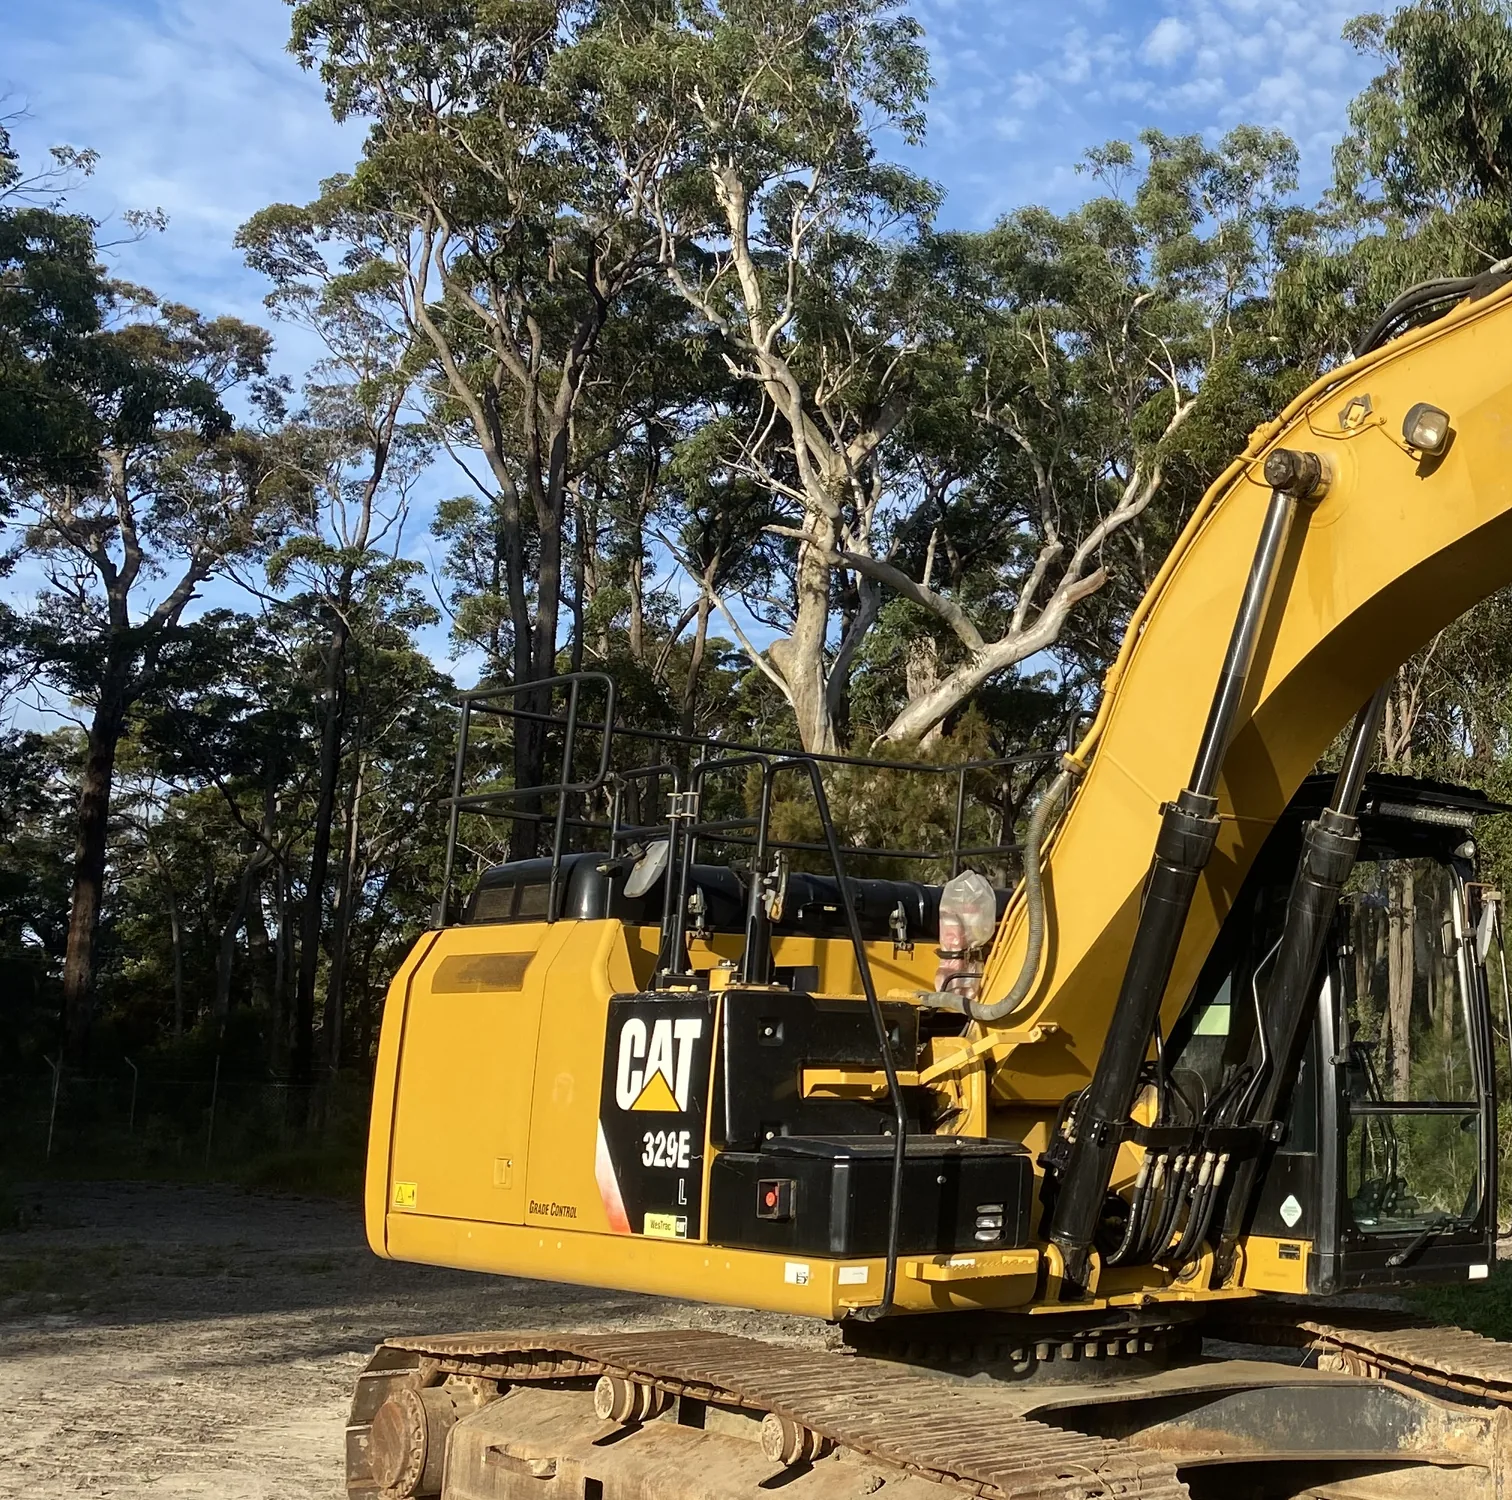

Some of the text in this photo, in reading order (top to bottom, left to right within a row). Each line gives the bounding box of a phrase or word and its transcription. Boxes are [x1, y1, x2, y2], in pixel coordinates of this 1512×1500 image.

[615, 1017, 703, 1113] CAT
[642, 1130, 691, 1169] 329E
[678, 1178, 688, 1206] L
[650, 1219, 672, 1231] WesTrac
